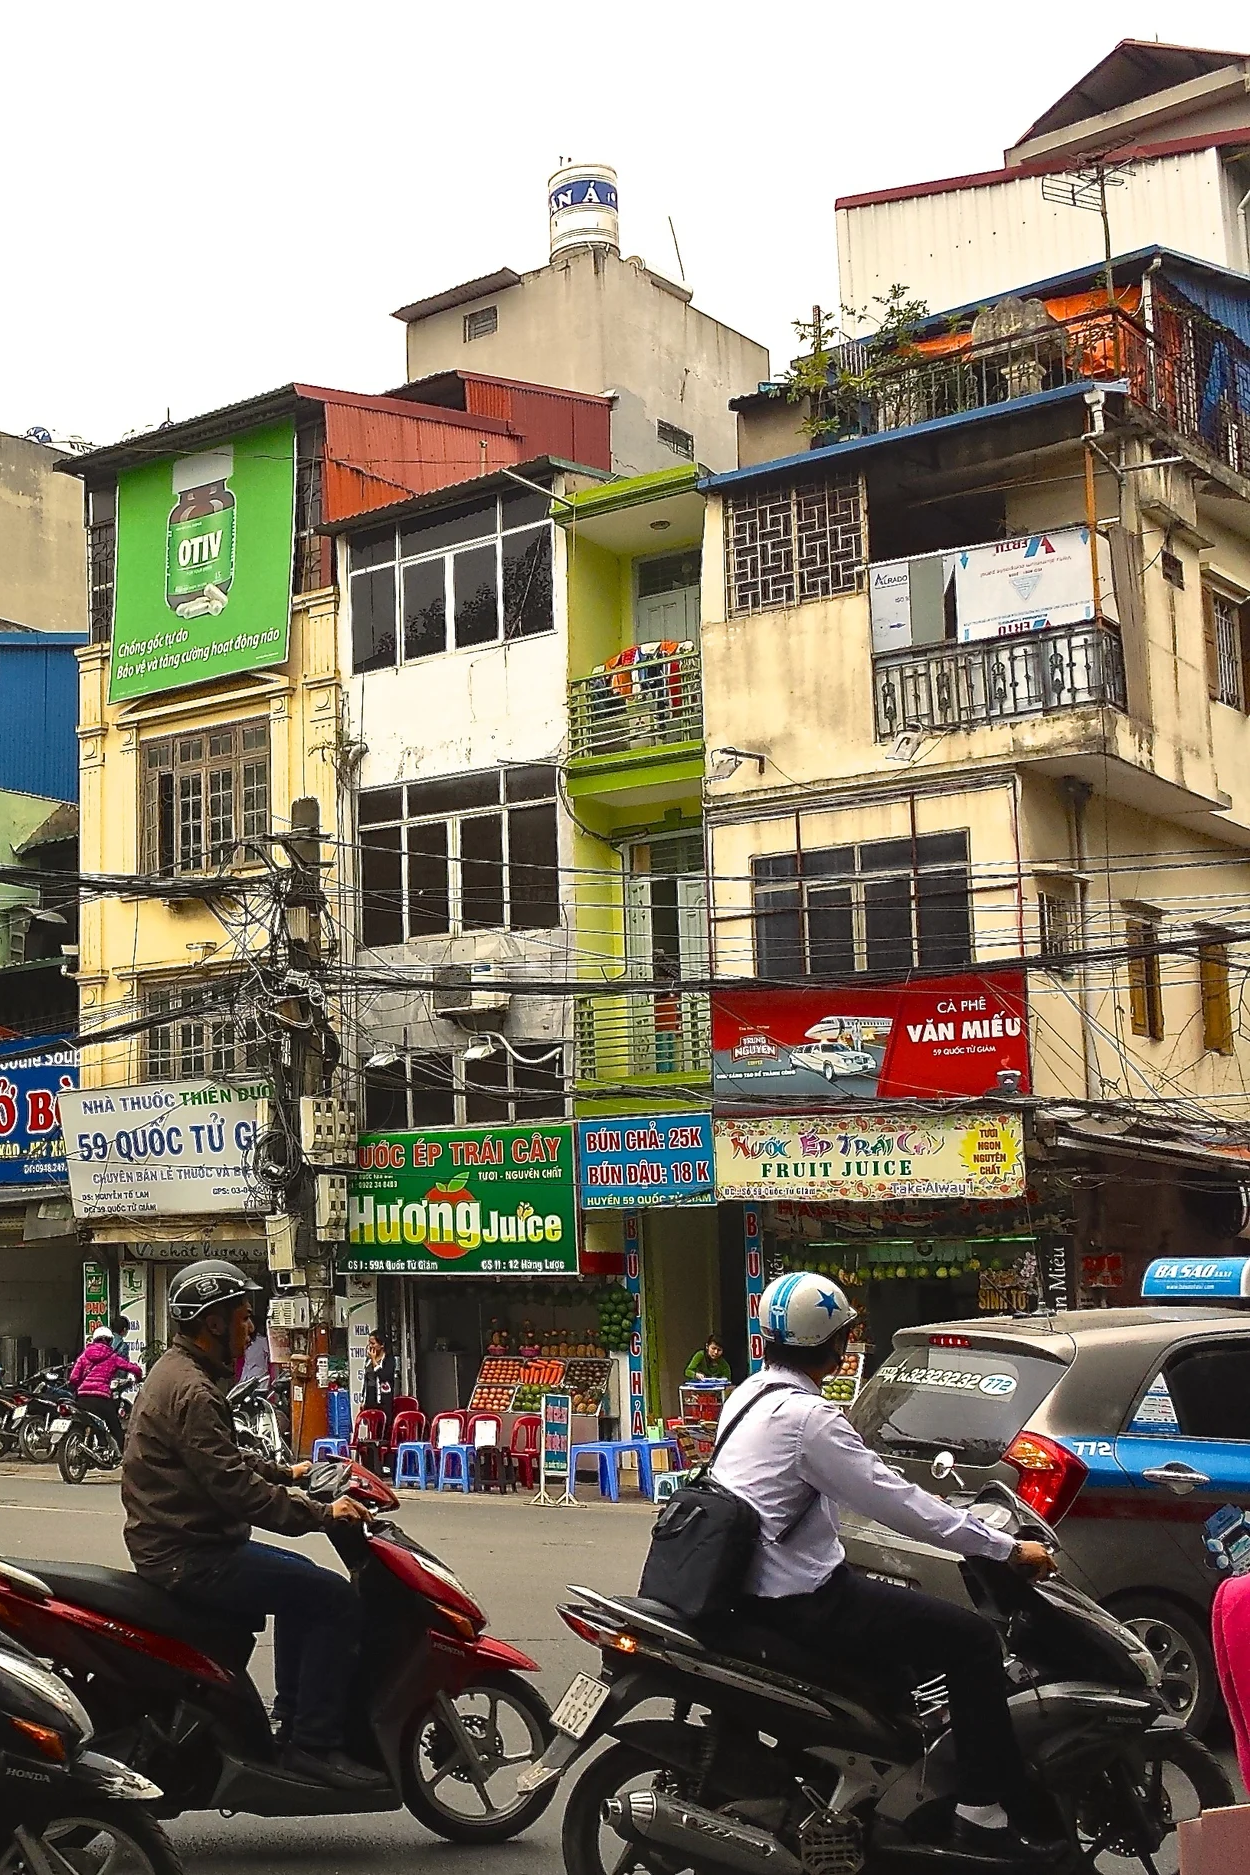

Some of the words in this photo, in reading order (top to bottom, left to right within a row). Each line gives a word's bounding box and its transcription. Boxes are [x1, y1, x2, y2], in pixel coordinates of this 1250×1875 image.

[118, 637, 145, 658] Chống
[147, 633, 164, 654] gốc
[176, 628, 189, 643] do
[159, 650, 180, 670] tăng
[181, 642, 209, 666] cường
[210, 640, 234, 657] hoạt
[234, 634, 259, 652] động
[260, 628, 280, 643] não
[937, 999, 956, 1014] CÀ
[960, 996, 987, 1011] PHÊ
[907, 1017, 955, 1043] VĂN
[961, 1010, 1021, 1040] MIẾU
[943, 1044, 966, 1057] QUỐC
[82, 1098, 115, 1115] NHÀ
[119, 1089, 176, 1112] THUỐC
[179, 1087, 232, 1107] THIÊN
[77, 1132, 108, 1162] 59
[115, 1114, 184, 1162] QUỐC
[189, 1112, 226, 1155] TỬ
[586, 1128, 622, 1153] BÚN
[668, 1126, 704, 1149] 25K
[977, 1140, 1001, 1151] NGON
[354, 1138, 405, 1169] ƯỚC
[413, 1138, 443, 1168] ÉP
[449, 1134, 504, 1166] TRÁI
[511, 1132, 562, 1164] CÂY
[973, 1152, 1007, 1163] NGUYÊN
[93, 1171, 134, 1185] CHUYÊN
[135, 1167, 158, 1182] BÁN
[176, 1165, 214, 1180] THUỐC
[587, 1160, 623, 1187] BÚN
[670, 1162, 693, 1183] 18
[696, 1161, 710, 1182] K
[761, 1161, 832, 1178] FRUIT
[842, 1159, 912, 1177] JUICE
[622, 1195, 636, 1206] 59
[349, 1194, 482, 1250] Hương
[481, 1207, 562, 1243] Juice
[386, 1259, 406, 1270] Quốc
[418, 1259, 438, 1270] Giám
[1154, 1264, 1177, 1279] BA
[1178, 1263, 1218, 1279] SAO
[983, 1378, 1013, 1391] 772
[1073, 1441, 1113, 1456] 772
[6, 1767, 51, 1782] HONDA
